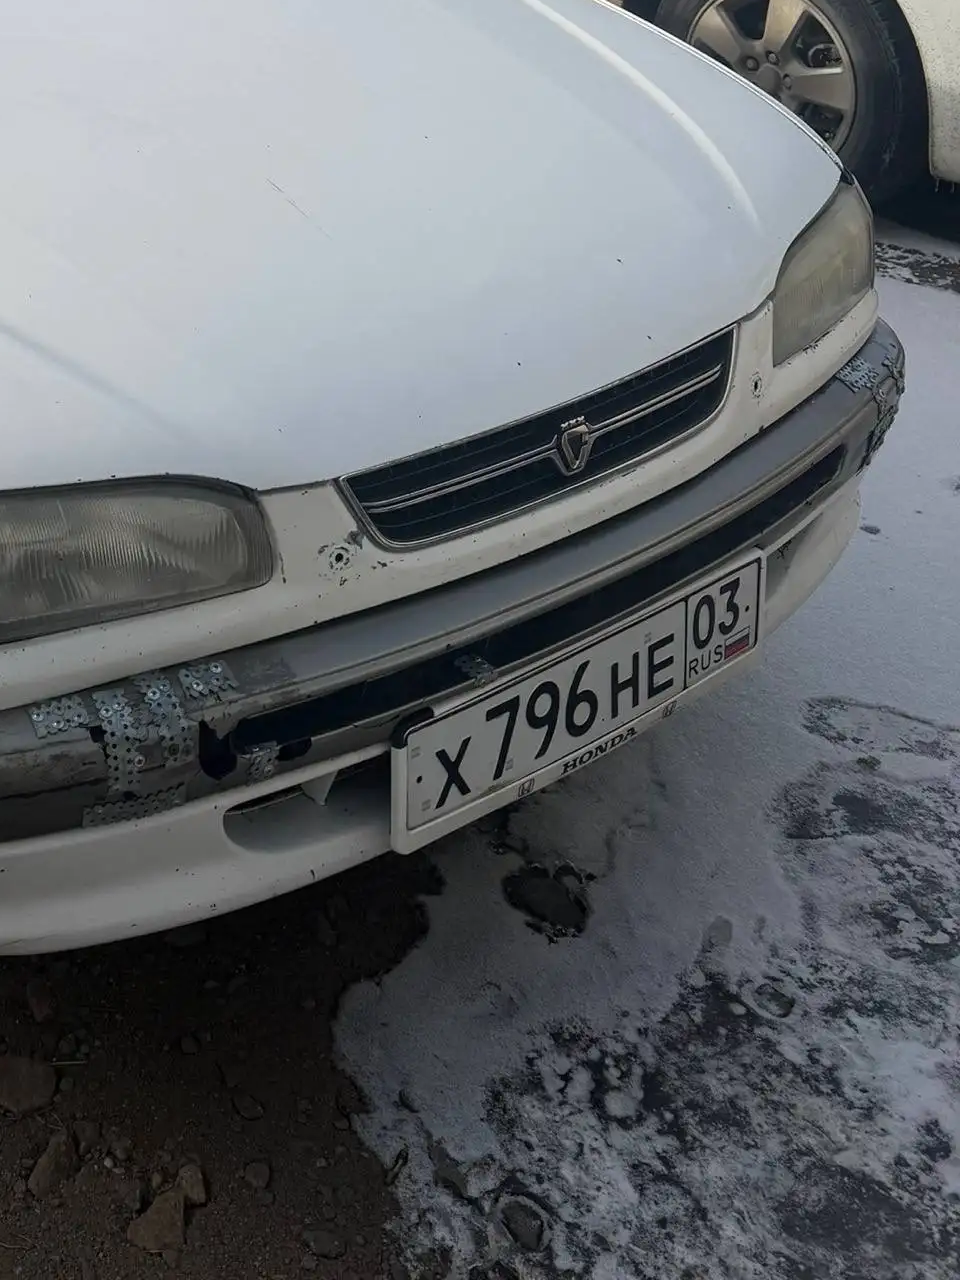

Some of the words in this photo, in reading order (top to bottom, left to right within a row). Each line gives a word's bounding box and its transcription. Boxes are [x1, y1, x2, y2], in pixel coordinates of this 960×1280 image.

[693, 577, 741, 650] 03
[688, 644, 724, 679] RUS
[561, 727, 638, 776] HONDA
